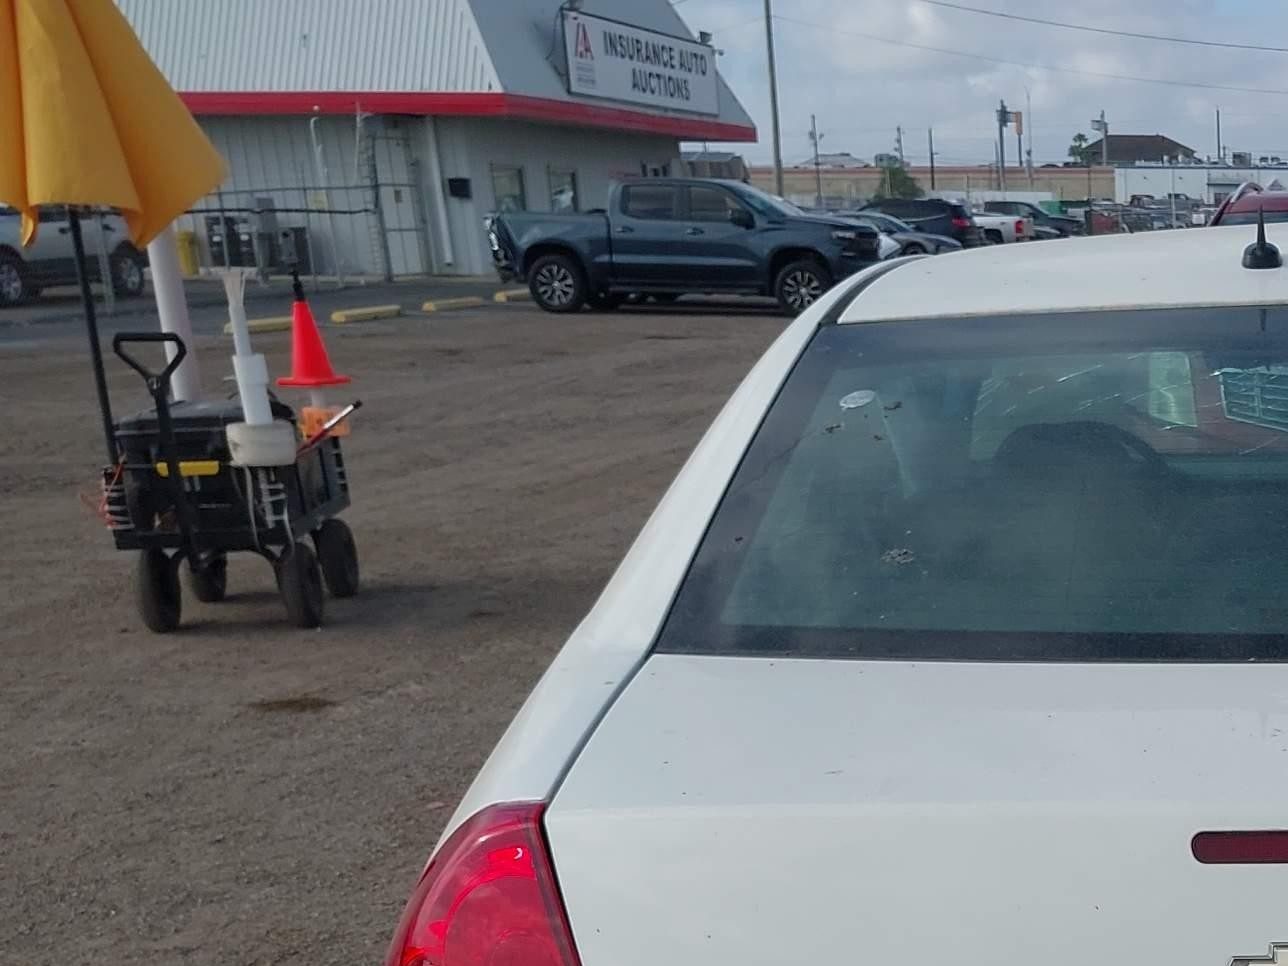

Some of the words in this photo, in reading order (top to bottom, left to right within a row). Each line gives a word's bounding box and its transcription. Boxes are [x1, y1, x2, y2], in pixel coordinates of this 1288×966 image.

[603, 31, 675, 69] INSURANCE
[679, 50, 708, 77] AUTO
[631, 68, 691, 101] AUCTIONS
